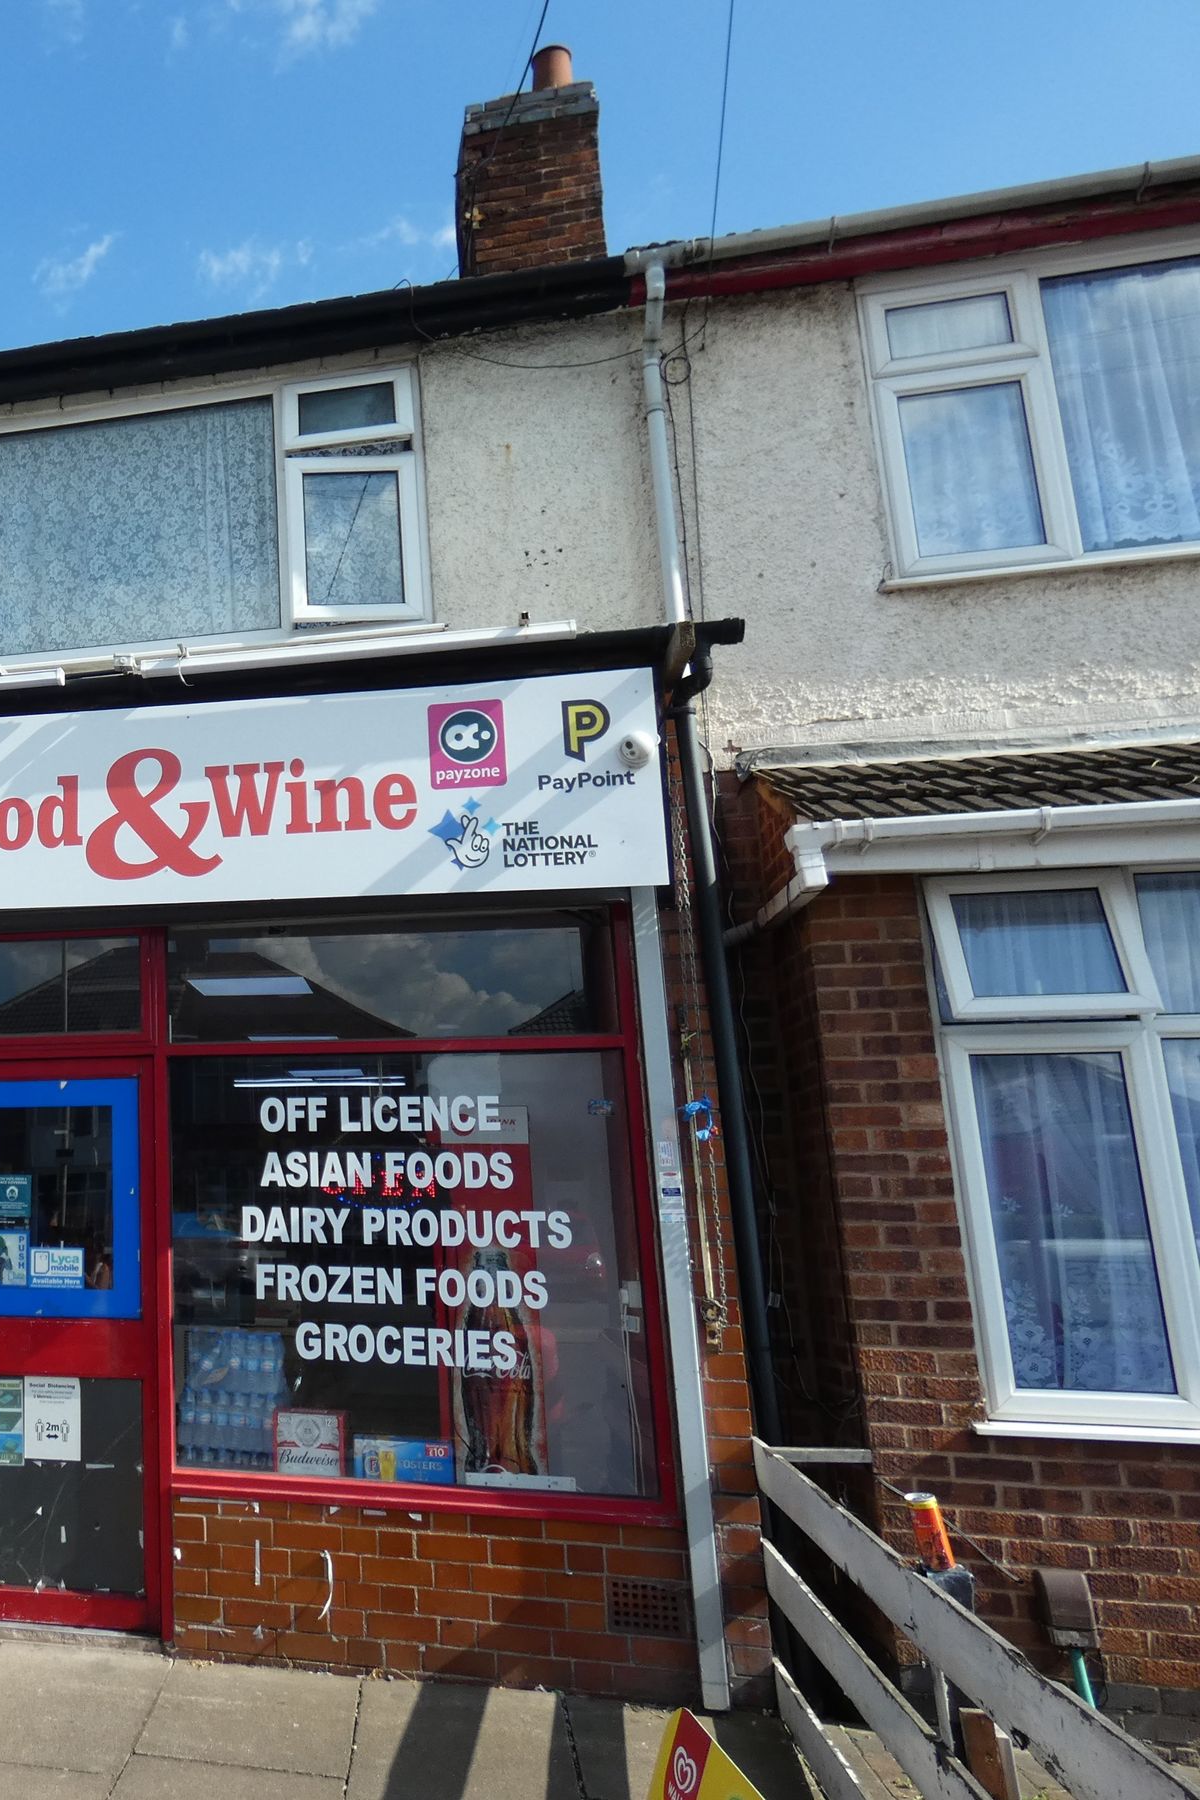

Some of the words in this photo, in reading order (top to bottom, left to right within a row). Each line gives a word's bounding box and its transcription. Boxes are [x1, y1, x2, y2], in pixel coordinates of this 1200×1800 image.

[435, 766, 501, 785] payzone
[537, 770, 636, 793] PayPoint
[85, 747, 223, 880] &
[204, 757, 419, 839] Wine
[502, 821, 540, 836] THE
[502, 834, 599, 852] NATIONAL
[260, 1096, 328, 1133] OFF
[340, 1095, 501, 1133] LICENCE
[260, 1151, 373, 1188] ASIAN
[386, 1151, 514, 1190] FOODS
[242, 1206, 352, 1245] DAIRY
[362, 1208, 573, 1249] PRODUCTS
[50, 1253, 79, 1264] Lyca
[50, 1264, 79, 1272] mobile
[256, 1263, 403, 1306] FROZEN
[416, 1267, 549, 1310] FOODS
[295, 1321, 518, 1371] GROCERIES
[45, 1421, 60, 1432] 2m
[279, 1449, 339, 1468] Budweiser
[429, 1447, 445, 1458] £10
